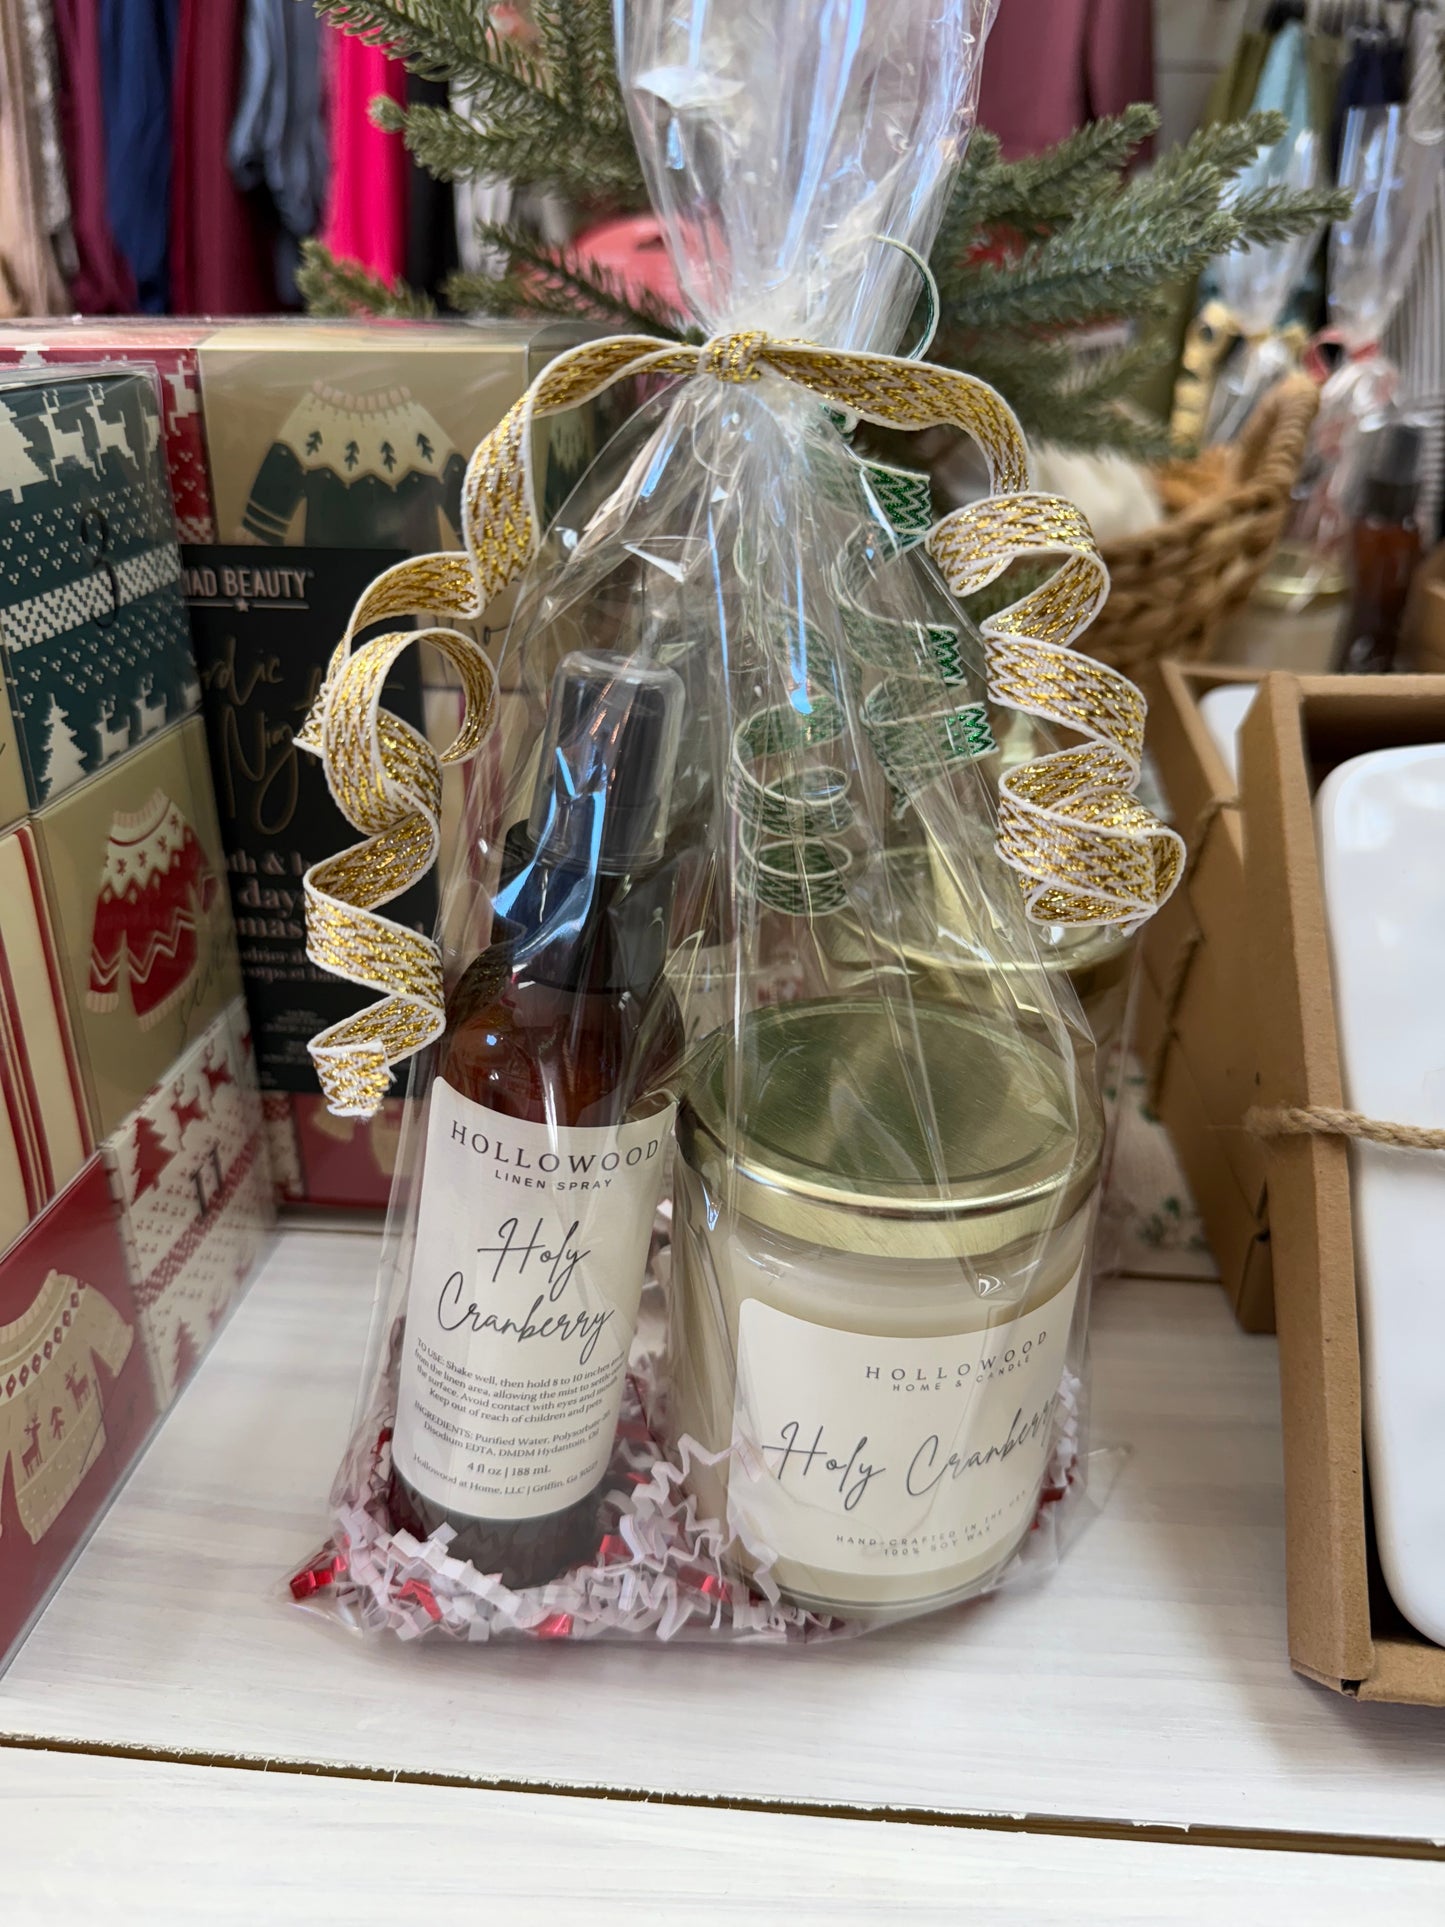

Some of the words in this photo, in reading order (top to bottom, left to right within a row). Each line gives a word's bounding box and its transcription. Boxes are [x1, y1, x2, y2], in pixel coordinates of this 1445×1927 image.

[223, 569, 307, 598] BEAUTY
[451, 1120, 659, 1173] HOLLOWOOD
[495, 1169, 546, 1189] LINEN
[557, 1178, 613, 1191] SPRAY
[477, 1217, 592, 1302] Holy
[438, 1271, 616, 1366] Cranberry
[417, 1337, 427, 1352] TO
[446, 1360, 473, 1379] Shake
[475, 1375, 498, 1387] well,
[500, 1378, 524, 1389] then
[527, 1379, 550, 1389] hold
[553, 1379, 558, 1387] 8
[561, 1377, 570, 1385] to
[573, 1373, 582, 1383] 10
[584, 1365, 610, 1380] inches
[865, 1331, 1047, 1381] HOLLOWOOD
[892, 1381, 941, 1392] HOME
[955, 1379, 962, 1388] &
[976, 1355, 1030, 1383] CANDLE
[417, 1364, 428, 1379] the
[461, 1393, 489, 1408] Avoid
[491, 1402, 530, 1412] contact
[533, 1401, 554, 1411] with
[557, 1398, 577, 1409] eyes
[579, 1389, 596, 1402] and
[430, 1363, 443, 1377] the
[444, 1371, 466, 1390] linen
[468, 1384, 491, 1397] area,
[493, 1389, 537, 1403] allowing
[540, 1390, 556, 1400] the
[558, 1387, 578, 1397] mist
[580, 1384, 590, 1392] to
[429, 1387, 450, 1407] Keep
[451, 1401, 466, 1413] out
[469, 1409, 479, 1418] of
[481, 1411, 509, 1423] reach
[511, 1415, 523, 1423] of
[524, 1411, 566, 1423] children
[567, 1404, 585, 1416] and
[424, 1421, 463, 1448] Disodium
[498, 1448, 535, 1458] DMDM
[475, 1433, 515, 1446] Purified
[413, 1453, 457, 1484] Hollowood
[504, 1486, 525, 1495] LLC
[467, 1462, 474, 1471] 4
[477, 1463, 485, 1473] fl
[487, 1467, 502, 1476] oz
[512, 1466, 530, 1477] 188
[762, 1421, 886, 1511] Holy
[836, 1529, 957, 1547] HAND-CRAFTED
[964, 1523, 977, 1534] IN
[884, 1548, 920, 1556] 100%
